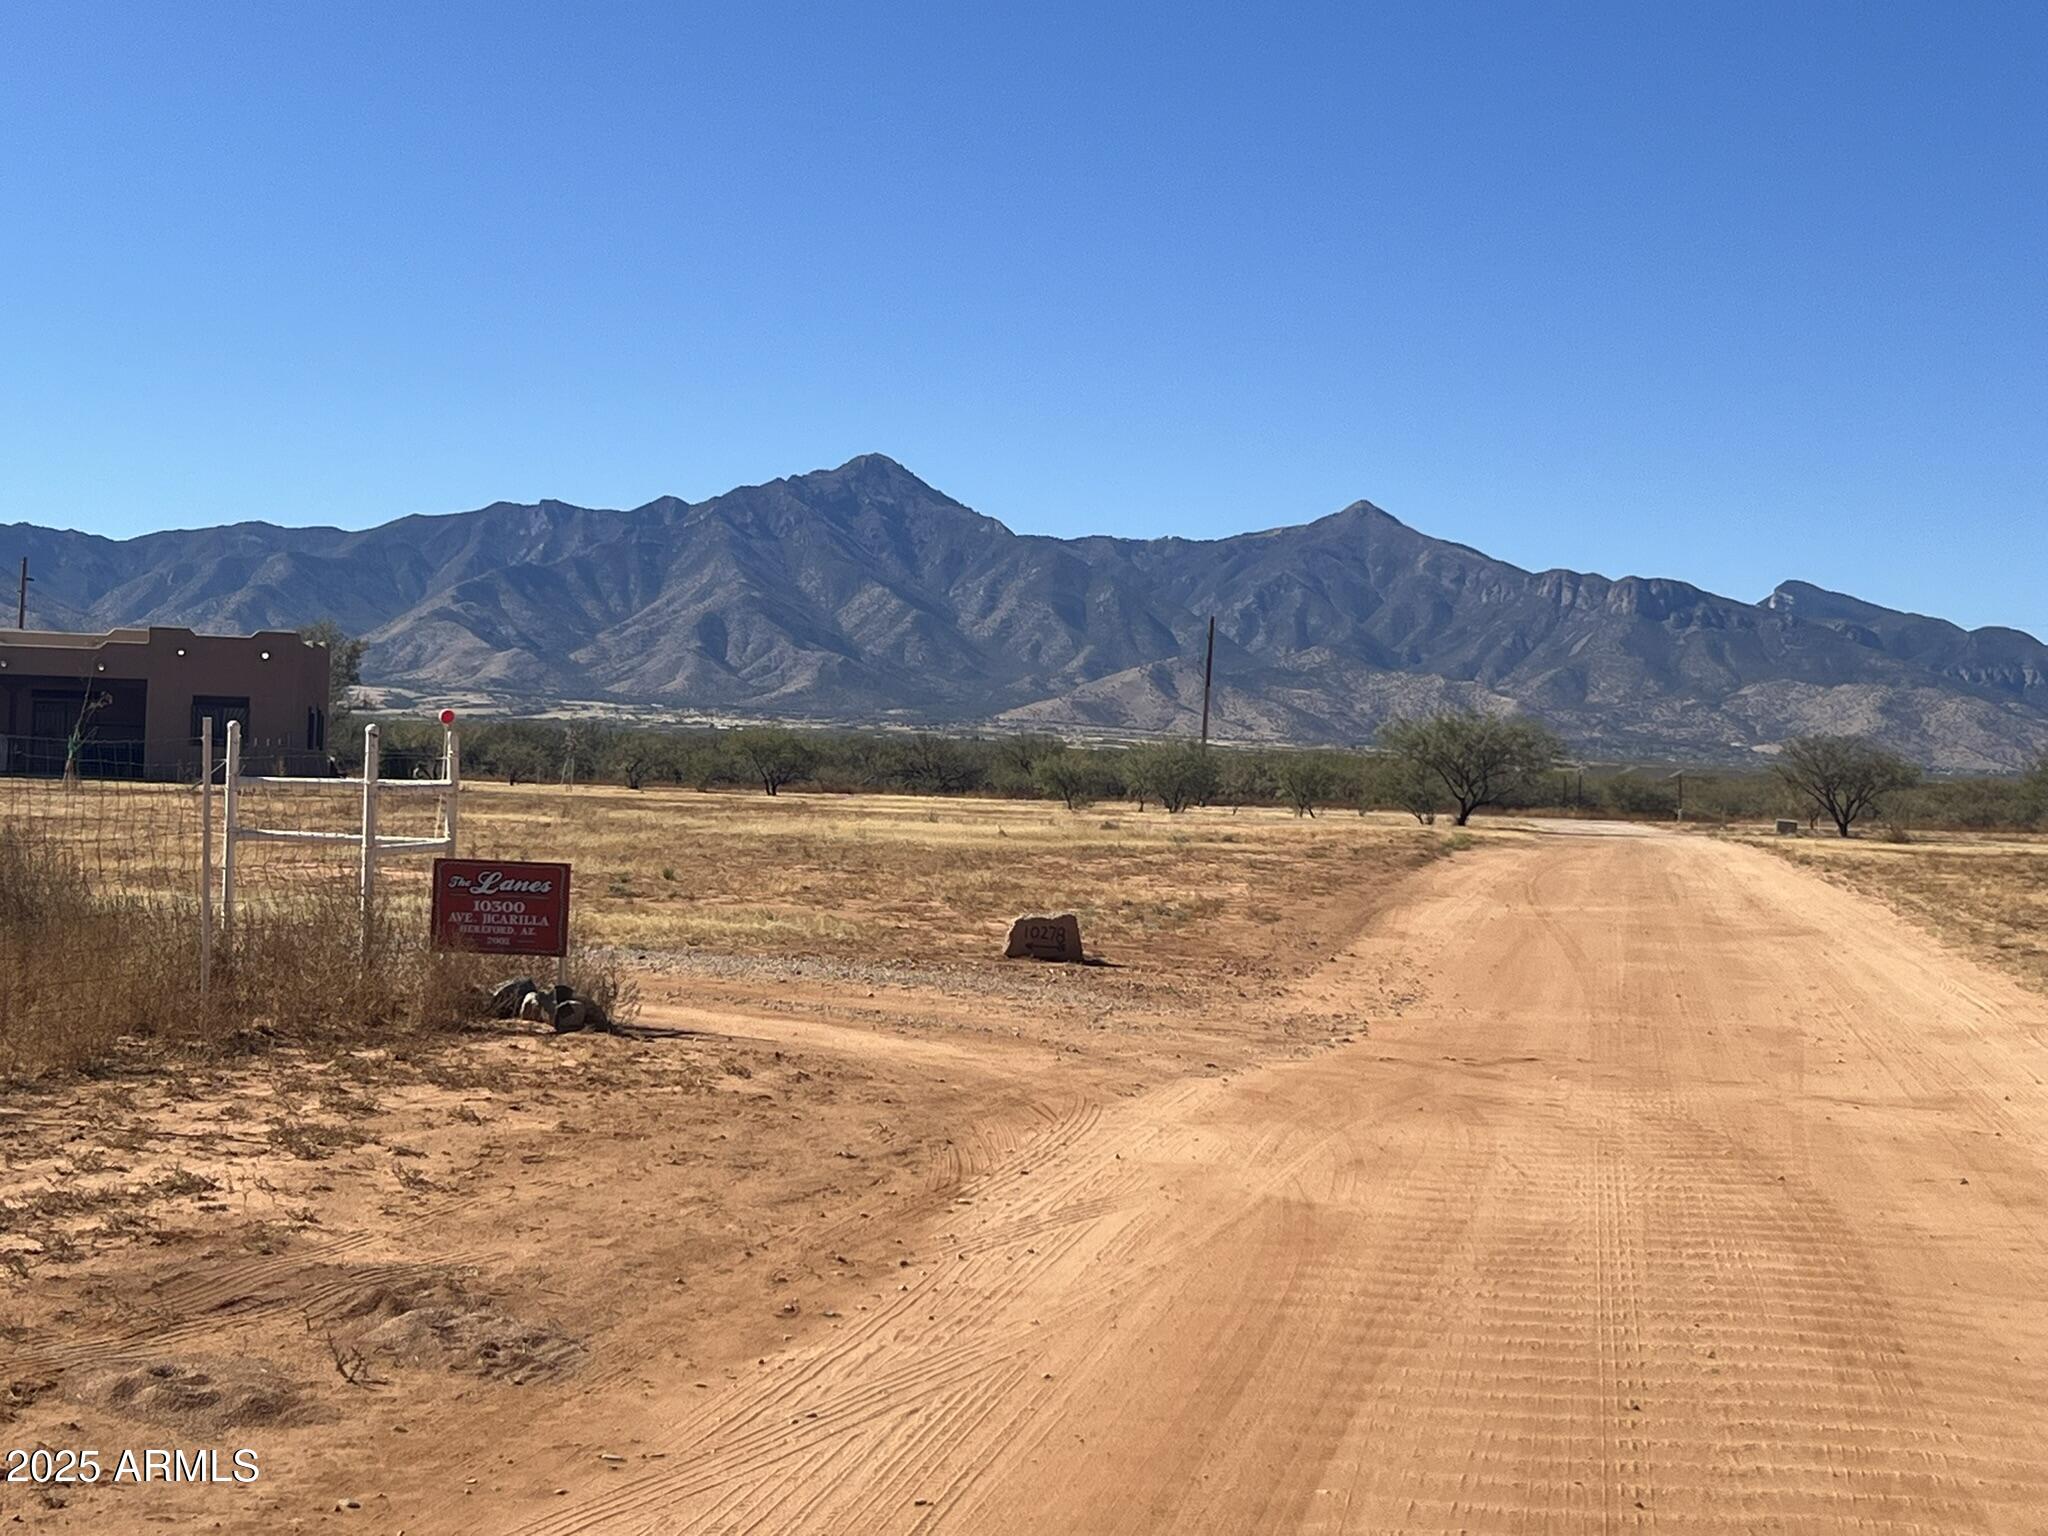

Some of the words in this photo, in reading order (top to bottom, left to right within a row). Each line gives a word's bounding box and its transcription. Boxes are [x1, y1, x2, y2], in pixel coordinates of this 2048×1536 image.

[448, 876, 472, 888] The
[469, 871, 552, 894] Lanes
[473, 900, 526, 914] 10300
[448, 912, 477, 923] AVE.
